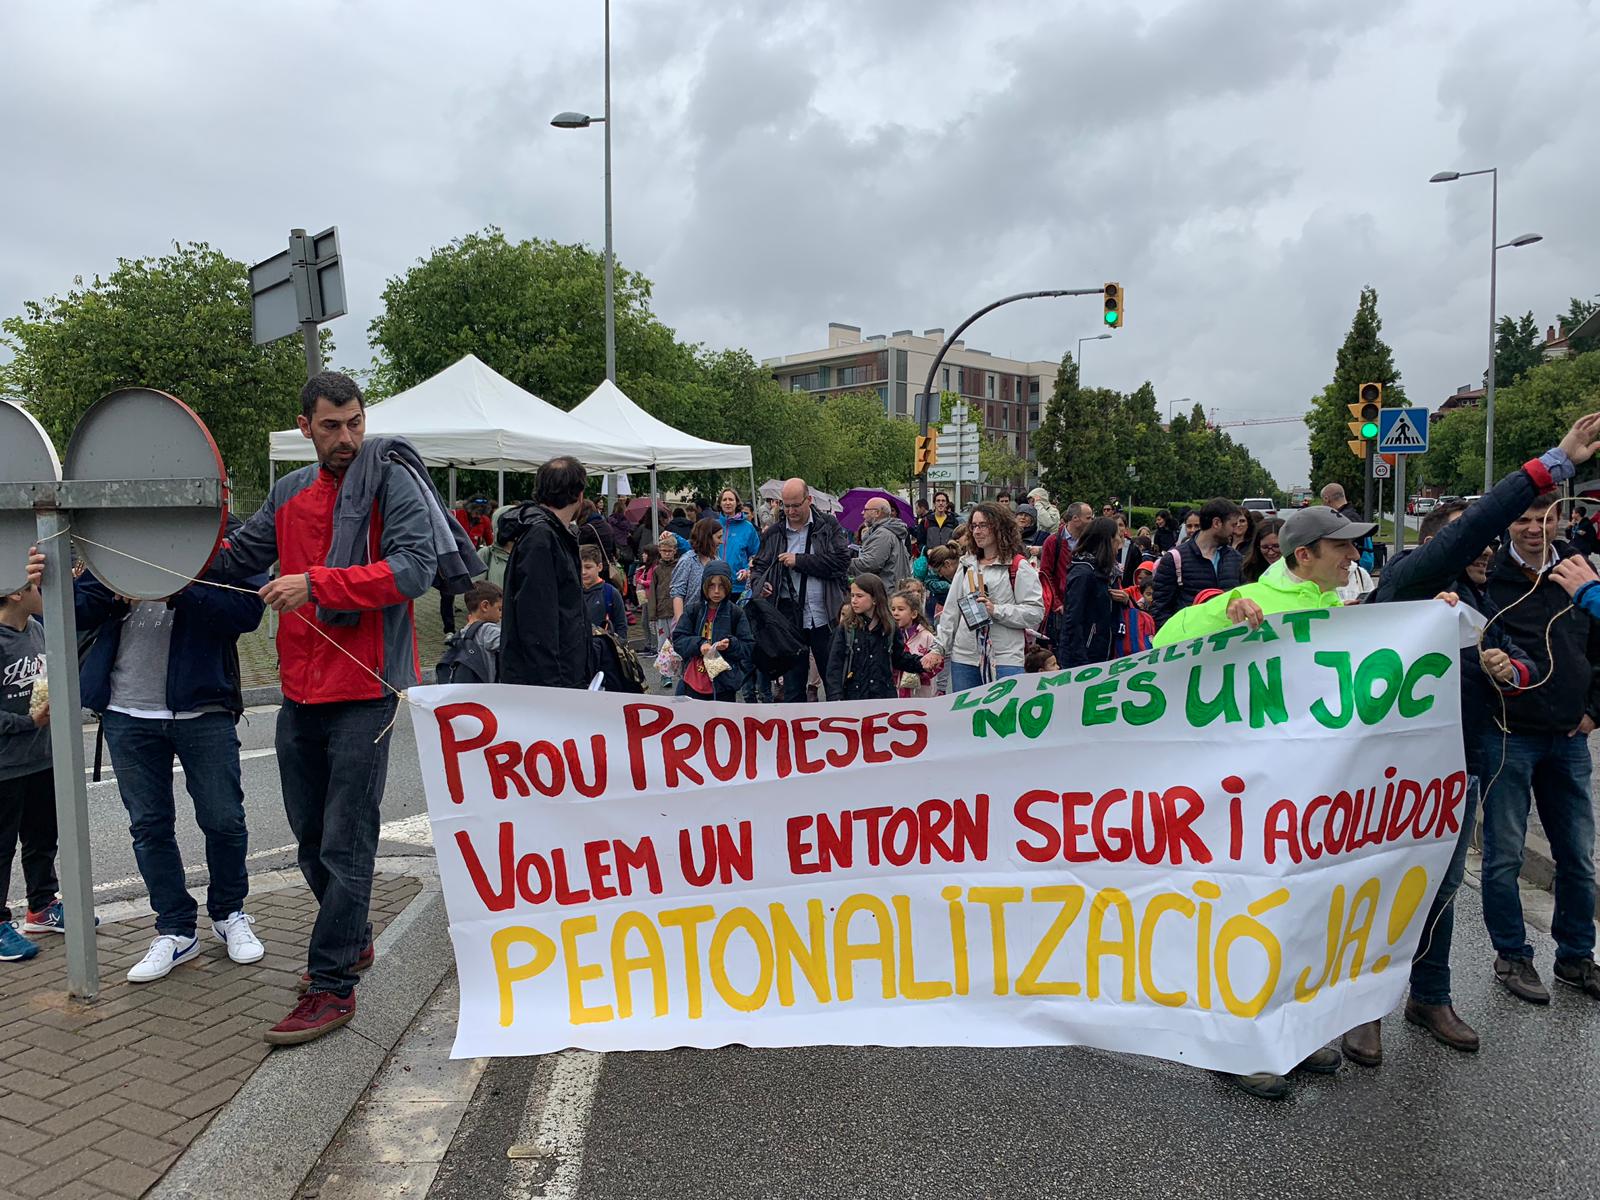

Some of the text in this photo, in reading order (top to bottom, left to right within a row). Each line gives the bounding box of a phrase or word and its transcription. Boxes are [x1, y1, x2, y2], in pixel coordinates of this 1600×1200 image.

[973, 693, 1054, 739] NO
[1186, 657, 1288, 729] UN
[1310, 648, 1452, 729] JOC
[434, 703, 927, 804] PROU PROMESES
[455, 821, 663, 912] VOLEM
[680, 821, 753, 886] UN
[787, 794, 989, 874] ENTORN
[1014, 786, 1213, 864] SEGUR
[1294, 865, 1428, 1003] JA!
